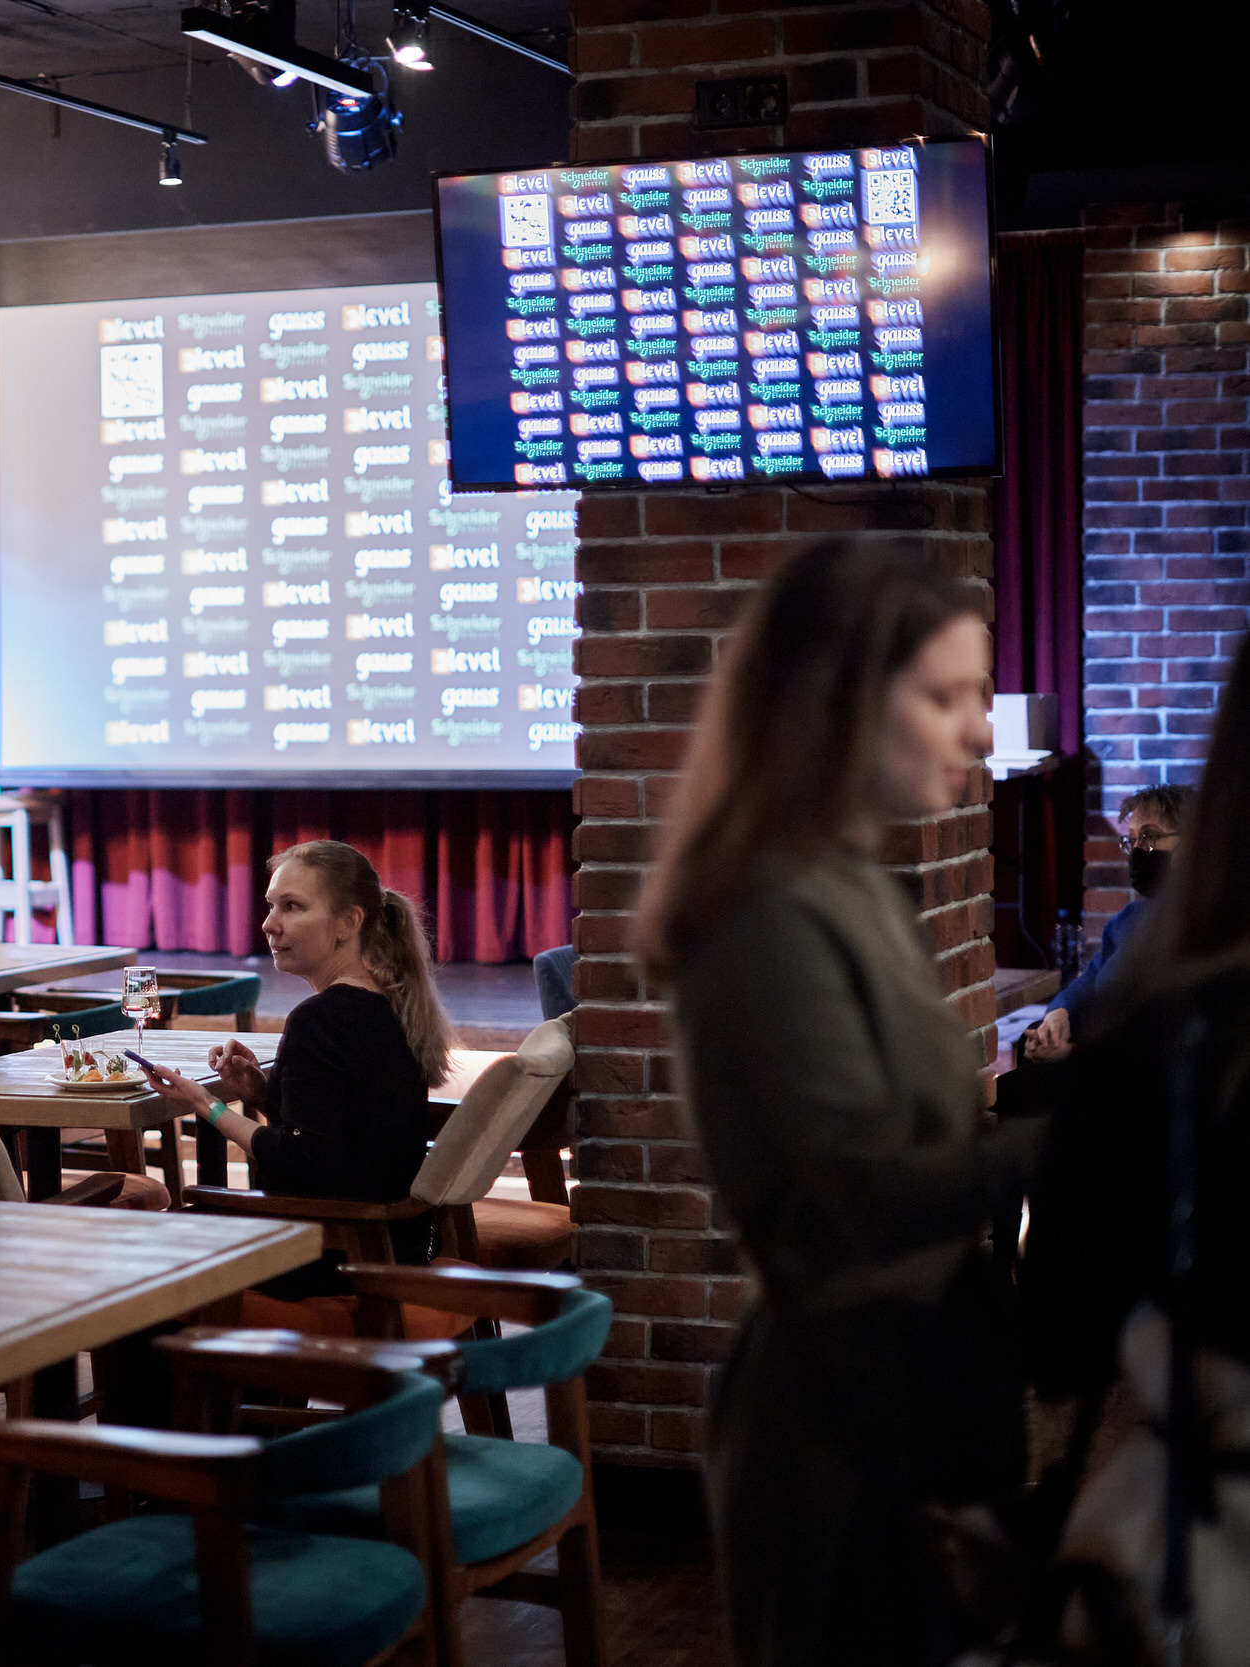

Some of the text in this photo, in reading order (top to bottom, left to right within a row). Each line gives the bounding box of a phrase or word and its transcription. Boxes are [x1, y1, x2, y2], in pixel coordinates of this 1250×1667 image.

[741, 158, 791, 170] Schneider
[810, 155, 850, 174] gauss
[561, 170, 609, 182] Schneider
[628, 168, 666, 186] gauss
[803, 179, 854, 191] Schneider
[621, 191, 670, 203] Schneider
[689, 189, 728, 207] gauss
[643, 200, 670, 208] Electric
[682, 212, 732, 224] Schneider
[751, 210, 790, 228] gauss
[571, 221, 609, 239] gauss
[704, 221, 732, 229] Electric
[744, 233, 794, 245] Schneider
[813, 231, 853, 249] gauss
[564, 244, 613, 256] Schneider
[631, 242, 670, 260] gauss
[586, 253, 613, 261] Electric
[806, 254, 857, 266] Schneider
[876, 252, 917, 271] gauss
[624, 265, 674, 277] Schneider
[692, 263, 731, 281] gauss
[515, 273, 552, 292] gauss
[646, 274, 674, 282] Electric
[869, 276, 921, 288] Schneider
[685, 286, 735, 298] Schneider
[754, 284, 793, 303] gauss
[508, 296, 556, 308] Schneider
[574, 294, 612, 313] gauss
[530, 305, 556, 313] Electric
[747, 308, 797, 320] Schneider
[816, 306, 856, 324] gauss
[568, 317, 616, 329] Schneider
[634, 315, 673, 334] gauss
[769, 317, 797, 325] Electric
[809, 329, 860, 341] Schneider
[879, 328, 920, 346] gauss
[628, 338, 677, 350] Schneider
[695, 337, 734, 355] gauss
[518, 346, 556, 364] gauss
[872, 351, 924, 363] Schneider
[689, 360, 738, 372] Schneider
[757, 359, 796, 377] gauss
[512, 368, 560, 380] Schneider
[578, 367, 616, 386] gauss
[750, 382, 800, 394] Schneider
[819, 381, 859, 399] gauss
[571, 390, 620, 402] Schneider
[638, 389, 676, 407] gauss
[772, 391, 800, 399] Electric
[593, 399, 620, 407] Electric
[812, 404, 863, 416] Schneider
[882, 403, 923, 421] gauss
[631, 412, 680, 424] Schneider
[699, 411, 738, 429] gauss
[522, 418, 559, 437] gauss
[653, 421, 680, 429] Electric
[875, 426, 927, 438] Schneider
[692, 434, 742, 446] Schneider
[760, 433, 800, 451] gauss
[515, 441, 563, 453] Schneider
[581, 440, 619, 458] gauss
[714, 443, 742, 451] Electric
[537, 450, 563, 458] Electric
[753, 456, 804, 468] Schneider
[822, 455, 862, 474] gauss
[575, 463, 623, 475] Schneider
[641, 462, 680, 480] gauss
[776, 465, 804, 473] Electric
[596, 472, 623, 480] Electric
